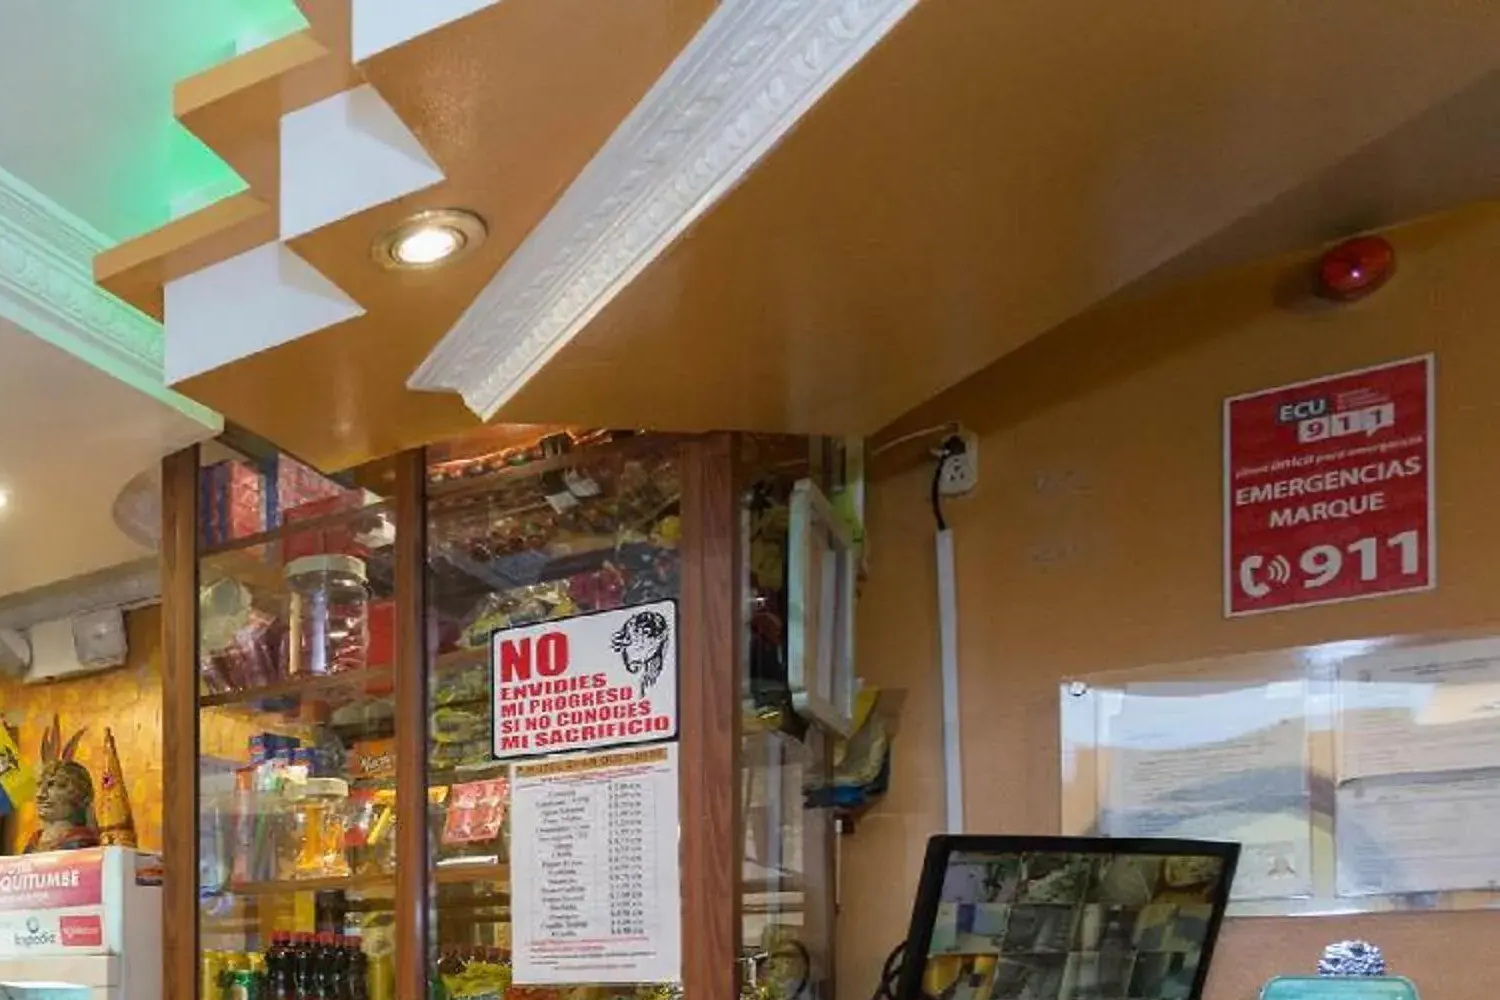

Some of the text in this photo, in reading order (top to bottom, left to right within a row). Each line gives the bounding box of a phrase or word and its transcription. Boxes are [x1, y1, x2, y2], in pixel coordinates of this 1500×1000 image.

[1280, 399, 1326, 422] ECU
[1236, 455, 1422, 506] EMERGENCIAS
[1270, 493, 1387, 529] MARQUE
[1301, 530, 1419, 588] 911
[501, 632, 569, 683] NO
[502, 673, 608, 700] ENVIDIES
[502, 687, 632, 718] MI PROGRESO
[501, 716, 670, 750] MI SACRIFICIO
[502, 700, 651, 734] SI NO CONOCES
[0, 868, 80, 893] QUITUMBE
